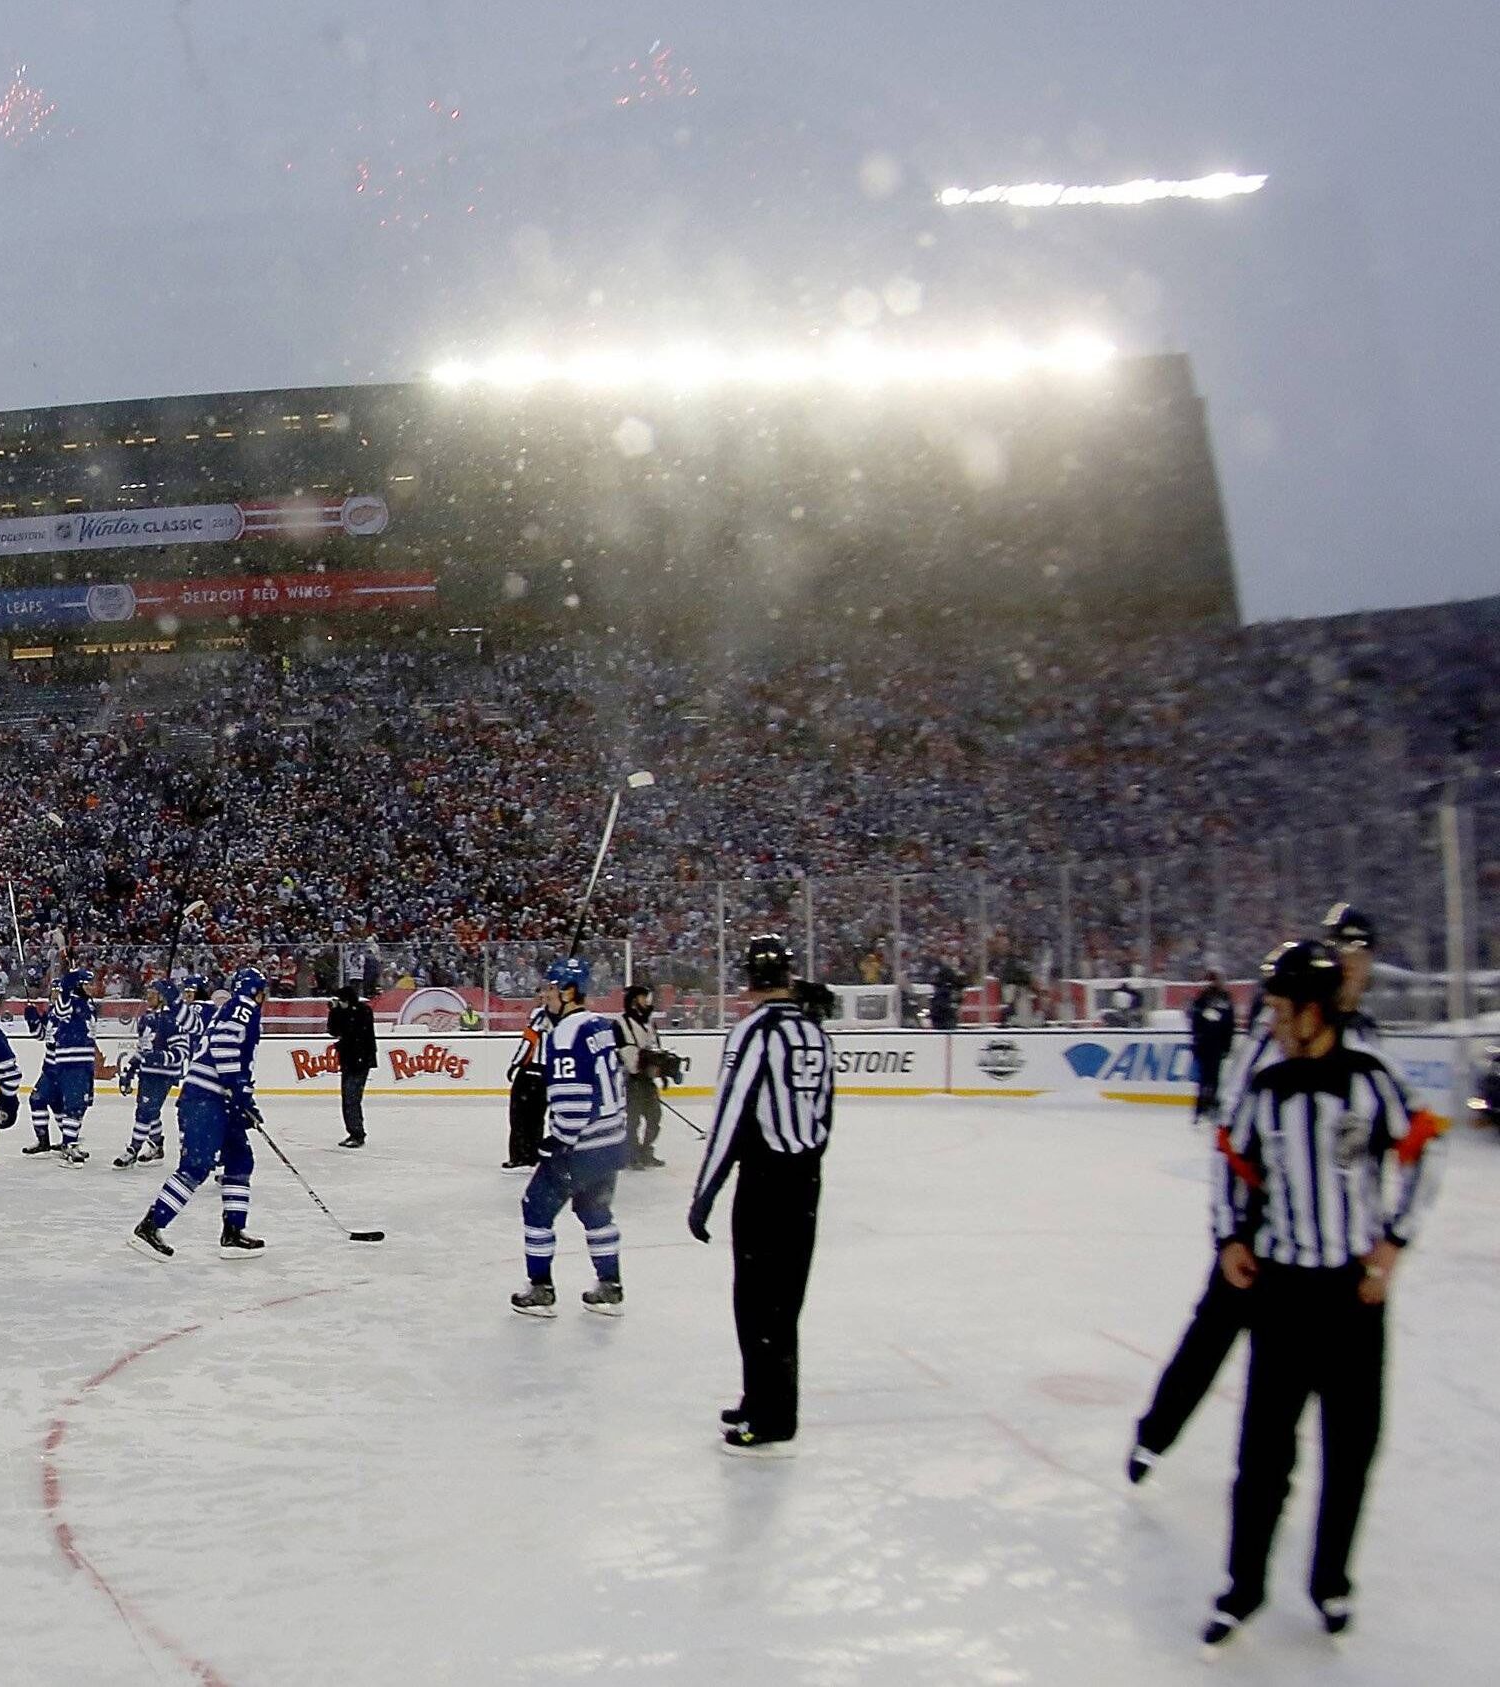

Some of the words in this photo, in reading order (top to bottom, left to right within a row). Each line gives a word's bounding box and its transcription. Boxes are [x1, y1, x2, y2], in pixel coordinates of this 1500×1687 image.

[76, 515, 142, 542] Winter
[142, 518, 202, 533] CLASSIC
[182, 588, 245, 604] DETROIT
[253, 587, 278, 600] RED
[286, 585, 332, 600] WINGS
[6, 600, 43, 615] LEAFS
[231, 1005, 253, 1023] 15
[290, 1043, 341, 1081] Ruff
[388, 1043, 470, 1080] Ruffles
[553, 1056, 576, 1079] 12
